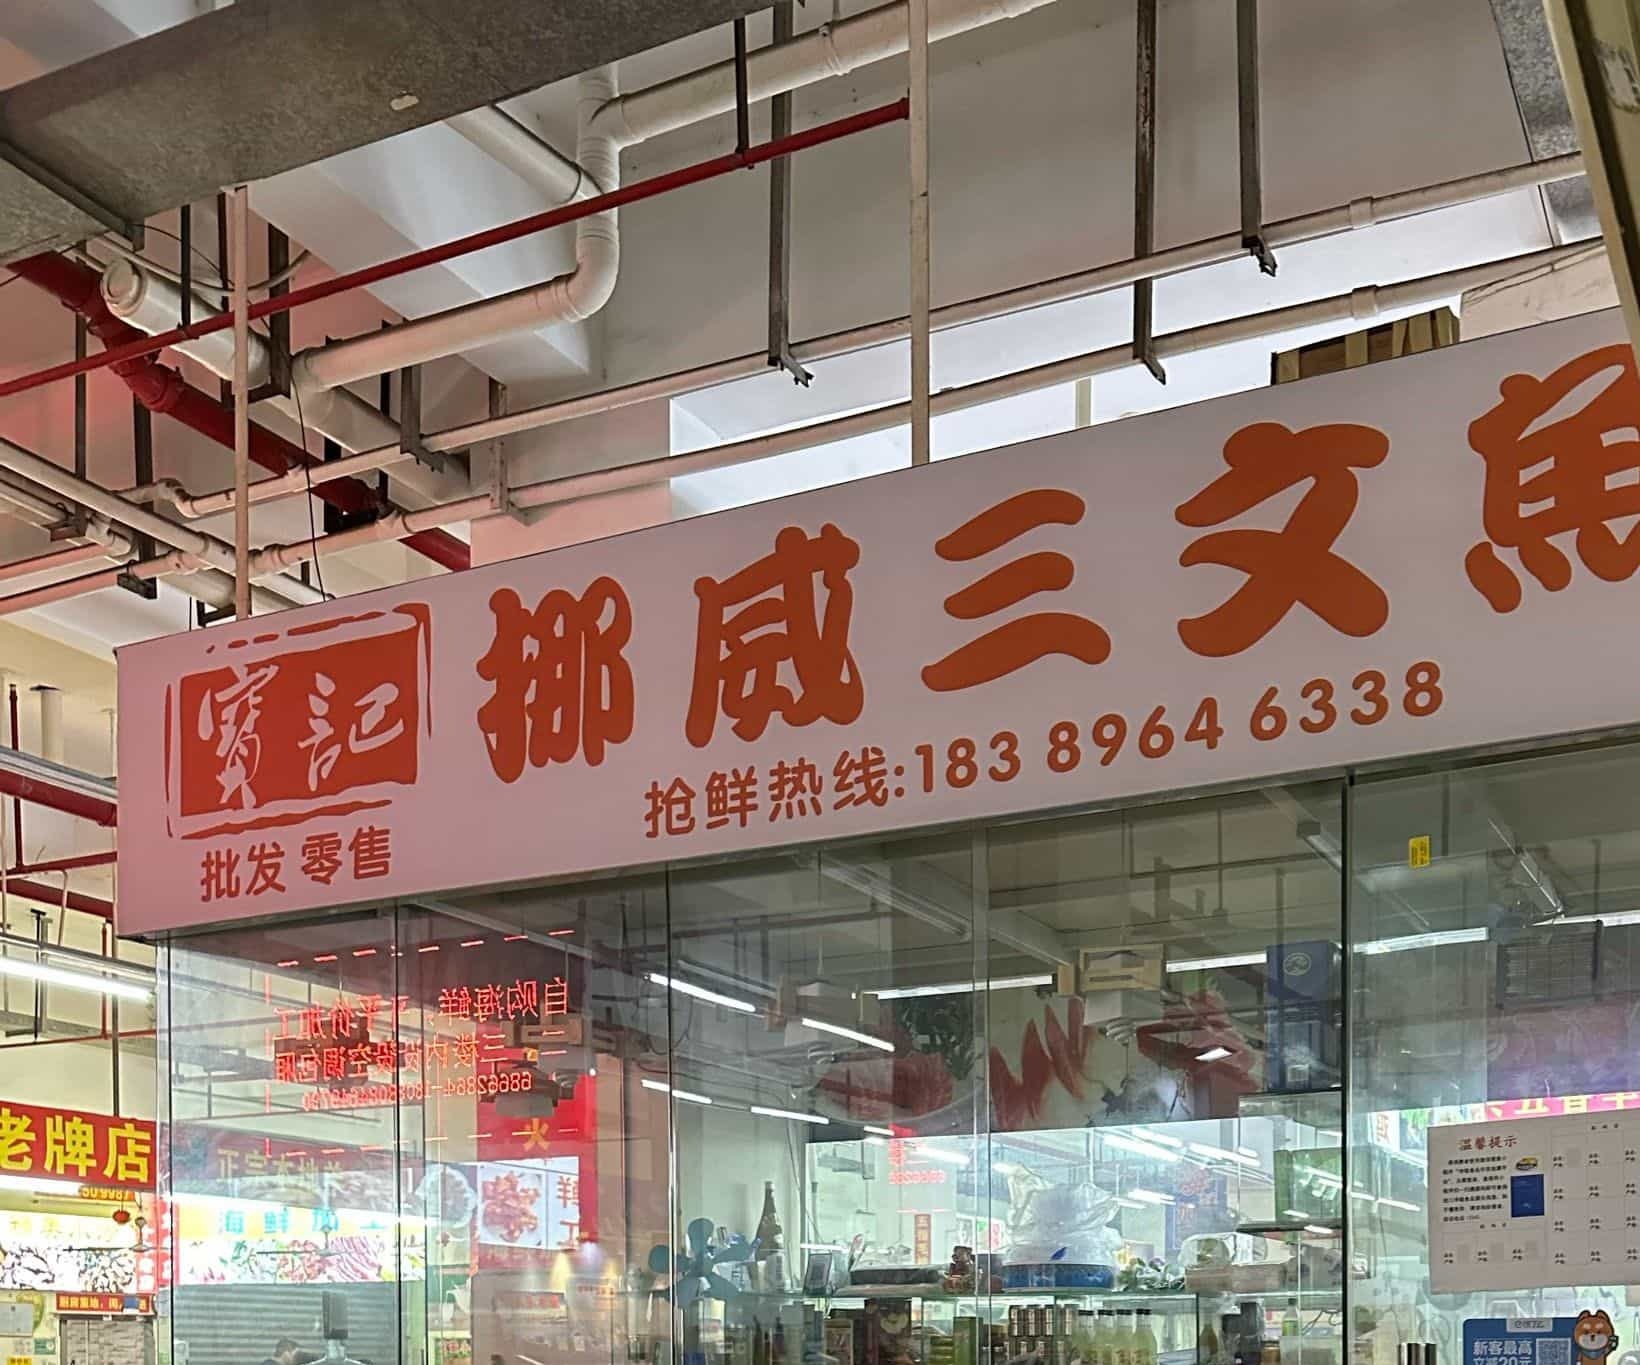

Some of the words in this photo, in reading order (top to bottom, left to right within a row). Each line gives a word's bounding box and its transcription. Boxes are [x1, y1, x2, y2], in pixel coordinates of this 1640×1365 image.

[1047, 697, 1224, 773] 8964
[1249, 661, 1444, 741] 6338
[201, 840, 286, 901] 批发
[301, 826, 392, 884] 零售
[0, 1107, 151, 1183] 老牌店
[1457, 1135, 1518, 1151] 温馨提示
[1472, 1339, 1533, 1356] 新客最高
